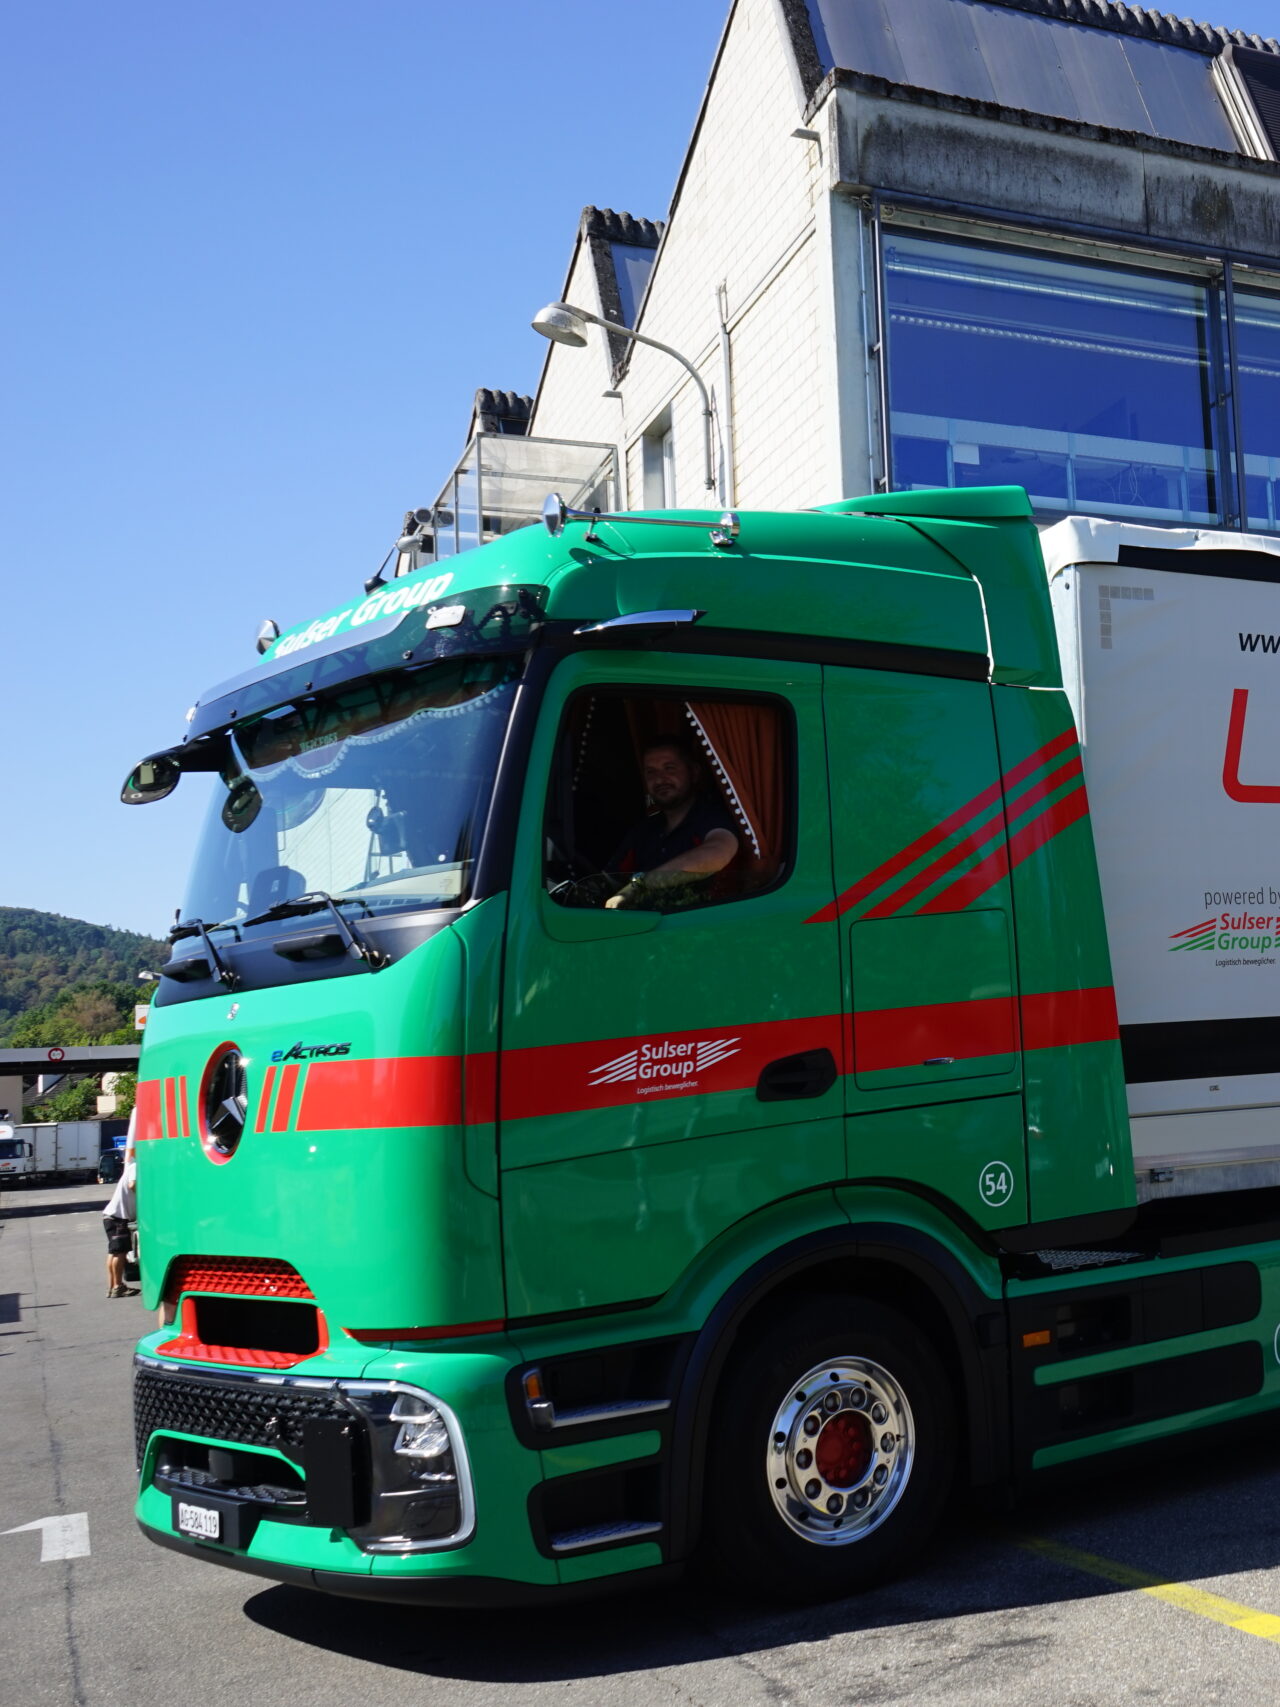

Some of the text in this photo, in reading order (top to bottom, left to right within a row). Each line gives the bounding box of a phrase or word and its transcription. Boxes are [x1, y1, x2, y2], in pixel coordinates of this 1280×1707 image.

[350, 572, 454, 627] Group
[1204, 887, 1264, 909] powered
[1219, 912, 1273, 931] Sulser
[1217, 932, 1272, 953] Group
[640, 1041, 696, 1061] Sulser
[638, 1060, 695, 1079] Group
[985, 1172, 1008, 1196] 54
